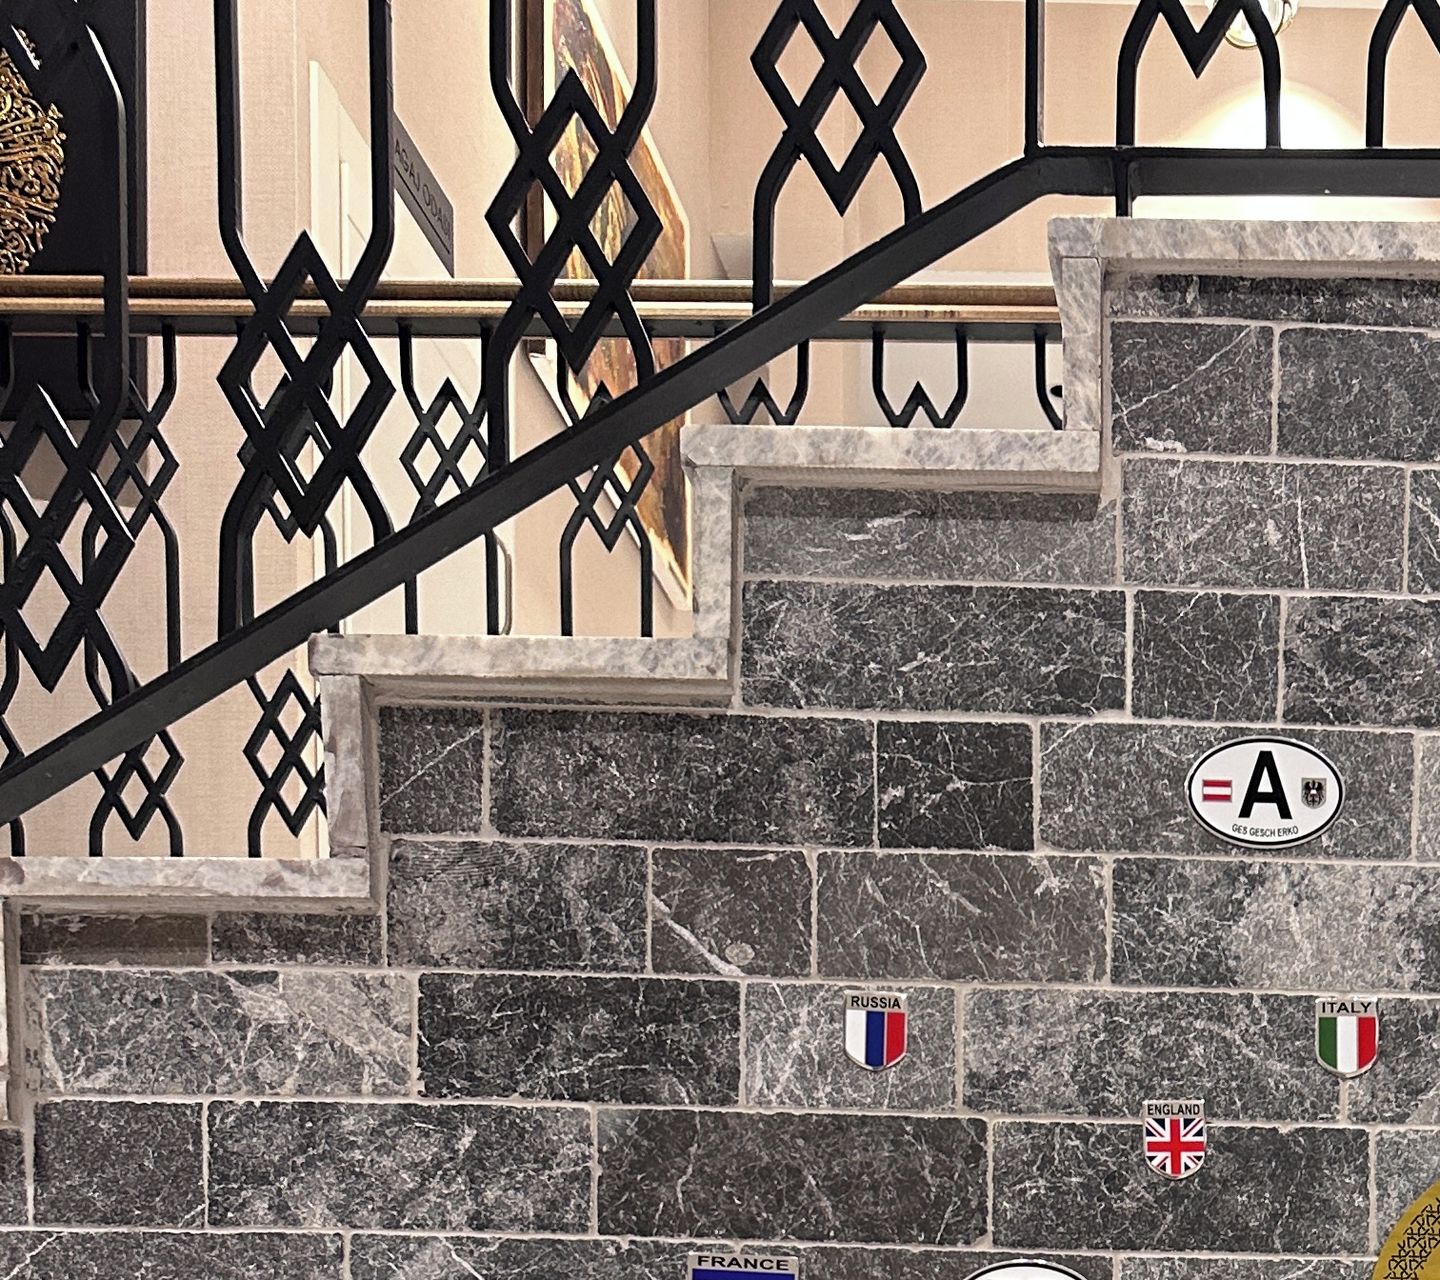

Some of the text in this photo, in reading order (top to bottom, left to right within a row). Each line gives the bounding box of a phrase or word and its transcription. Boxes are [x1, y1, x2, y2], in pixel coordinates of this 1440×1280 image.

[394, 138, 421, 192] AGAJ
[1238, 750, 1293, 820] A
[1231, 823, 1248, 835] GES
[1249, 824, 1276, 838] GESCH
[851, 995, 901, 1010] RUSSIA
[1321, 1001, 1372, 1014] ITALY
[1147, 1103, 1201, 1116] ENGLAND
[697, 1255, 790, 1271] FRANCE
